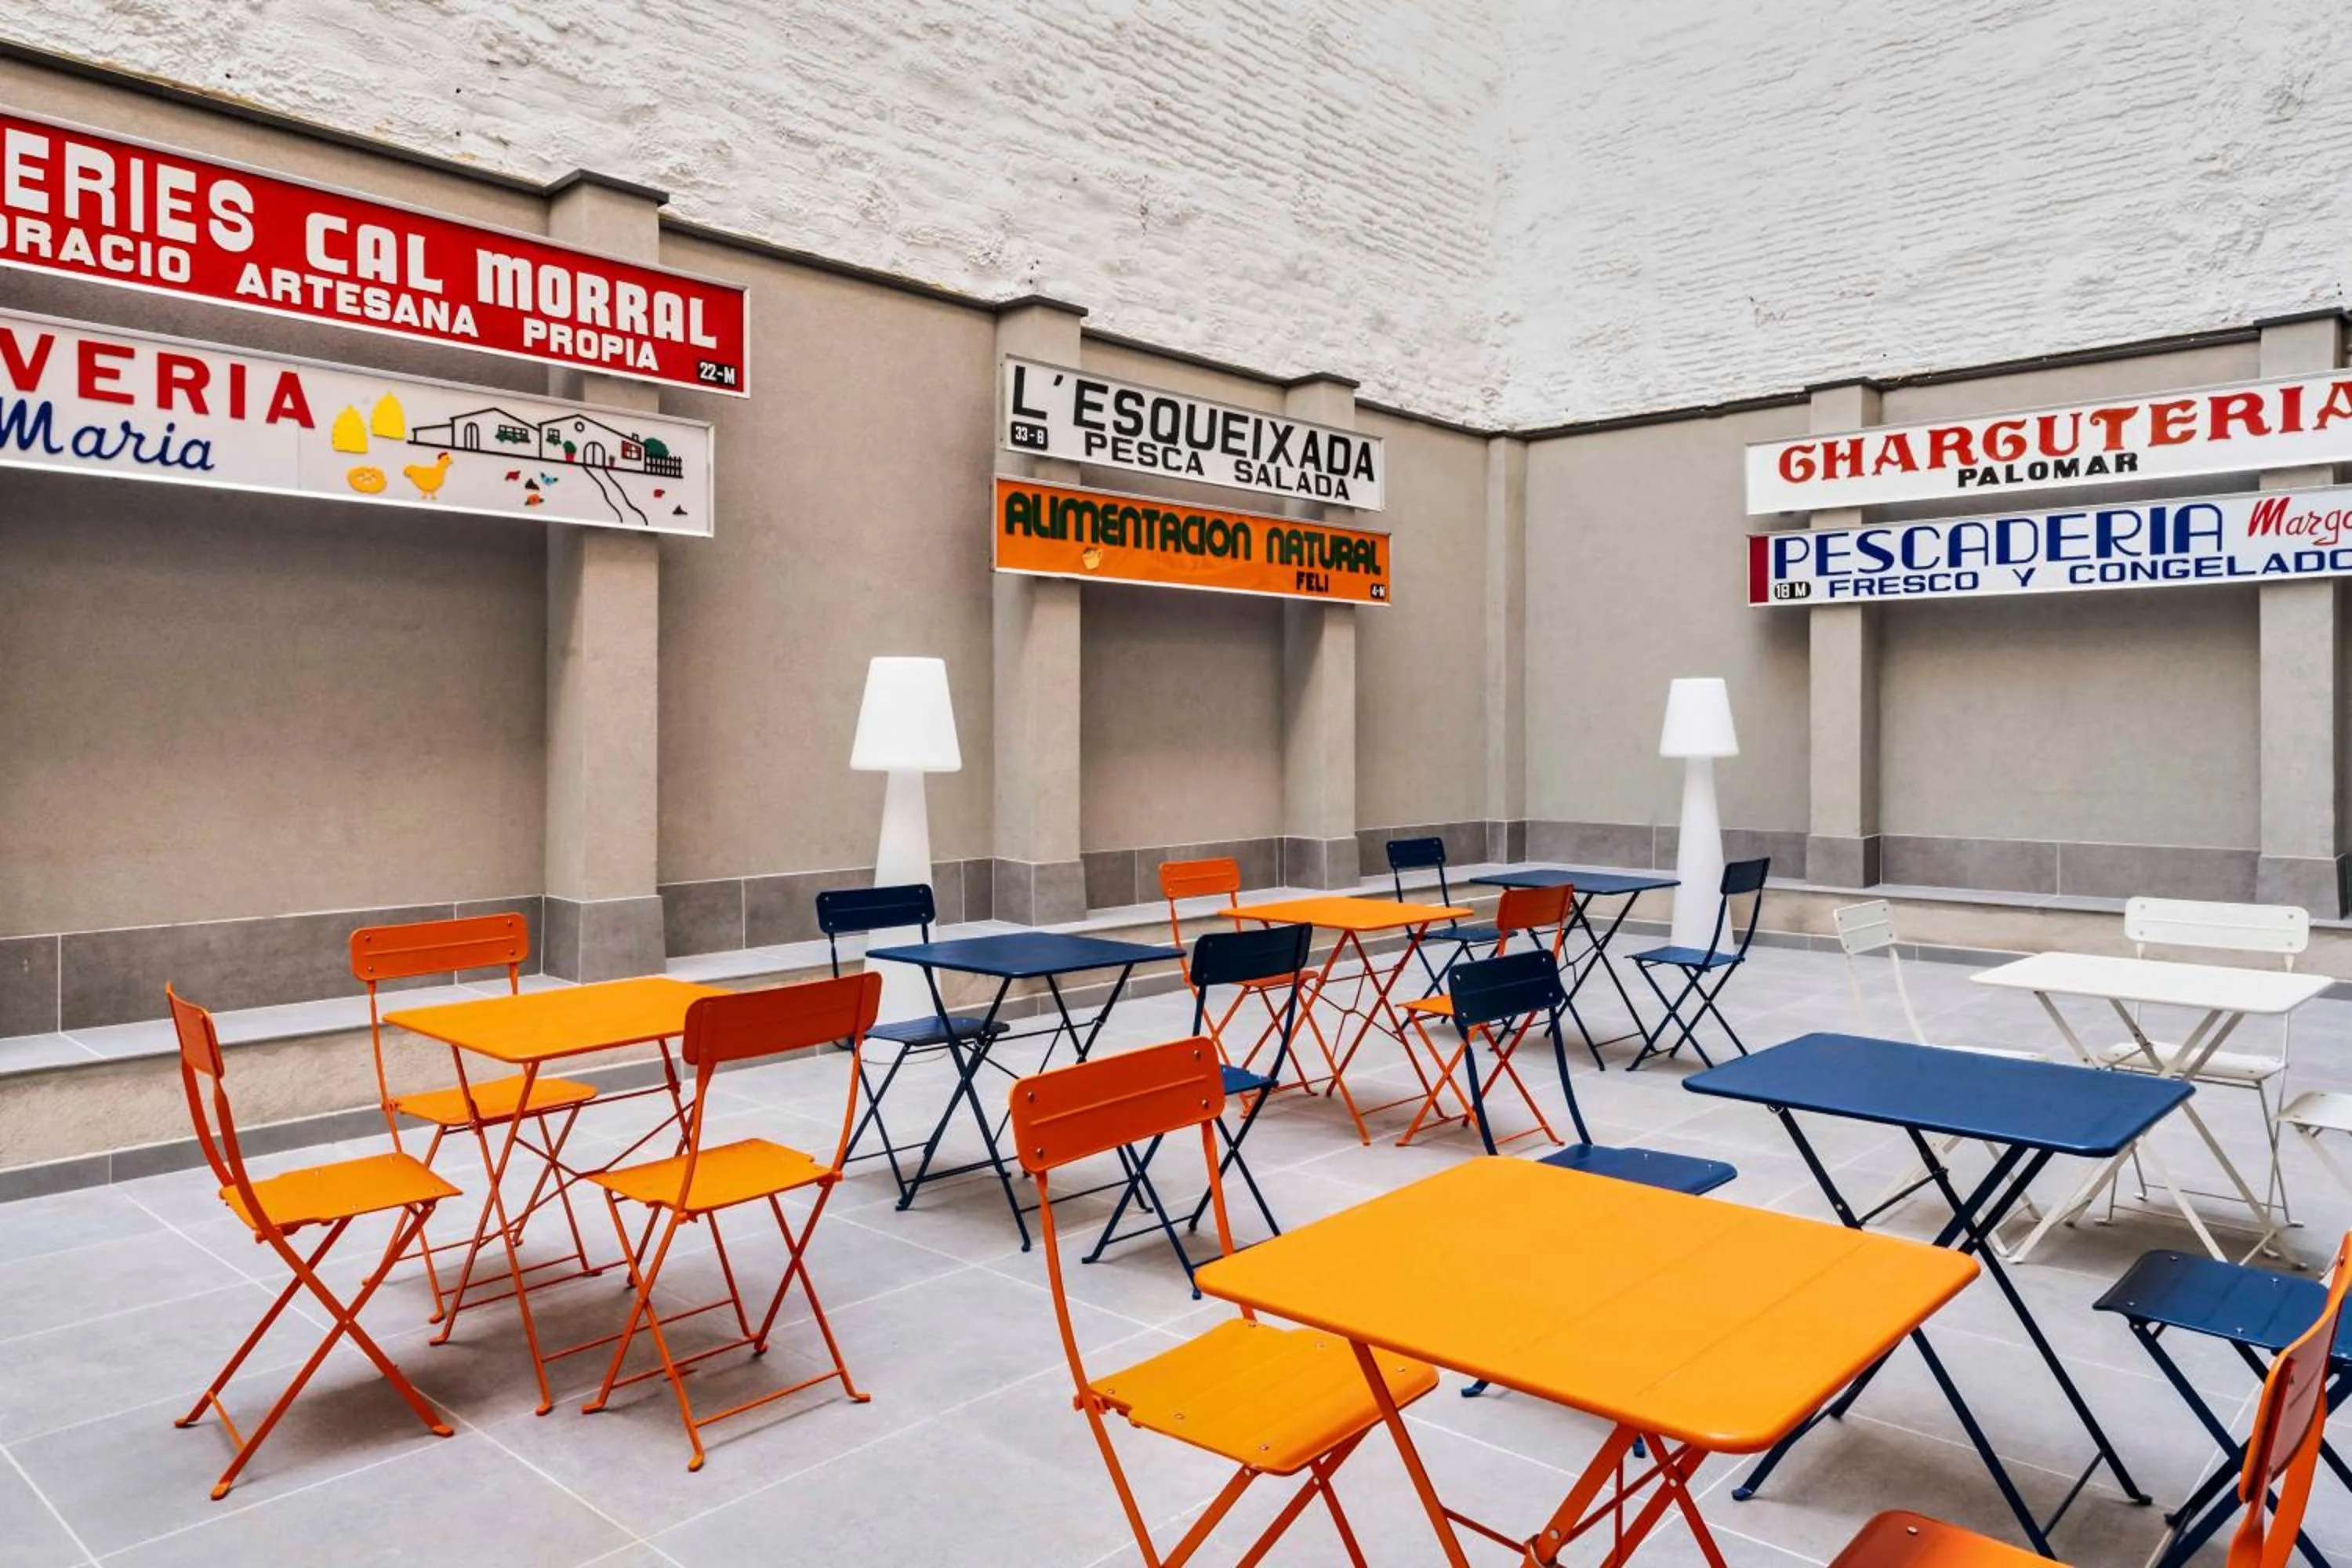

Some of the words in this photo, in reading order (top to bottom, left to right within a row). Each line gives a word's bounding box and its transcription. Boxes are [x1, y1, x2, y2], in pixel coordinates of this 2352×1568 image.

[5, 127, 255, 252] ERIES
[306, 212, 444, 294] CAL
[476, 248, 717, 350] MORRAL
[0, 213, 191, 283] RACIO
[236, 263, 479, 339] ARTESANA
[523, 317, 659, 372] PROPIA
[0, 326, 315, 429] VERIA
[699, 361, 735, 385] 22-M
[1084, 430, 1205, 476] PESCA
[1234, 459, 1350, 501] SALADA
[1958, 452, 2138, 488] PALOMAR
[1005, 492, 1251, 561] ALIMENTACION
[1266, 526, 1381, 575] NATURAL
[1774, 503, 2223, 579] PESCADERIA
[1296, 570, 1329, 593] FELI
[1776, 584, 1790, 598] 18
[1828, 571, 1980, 598] FRESCO
[2012, 568, 2035, 587] Y
